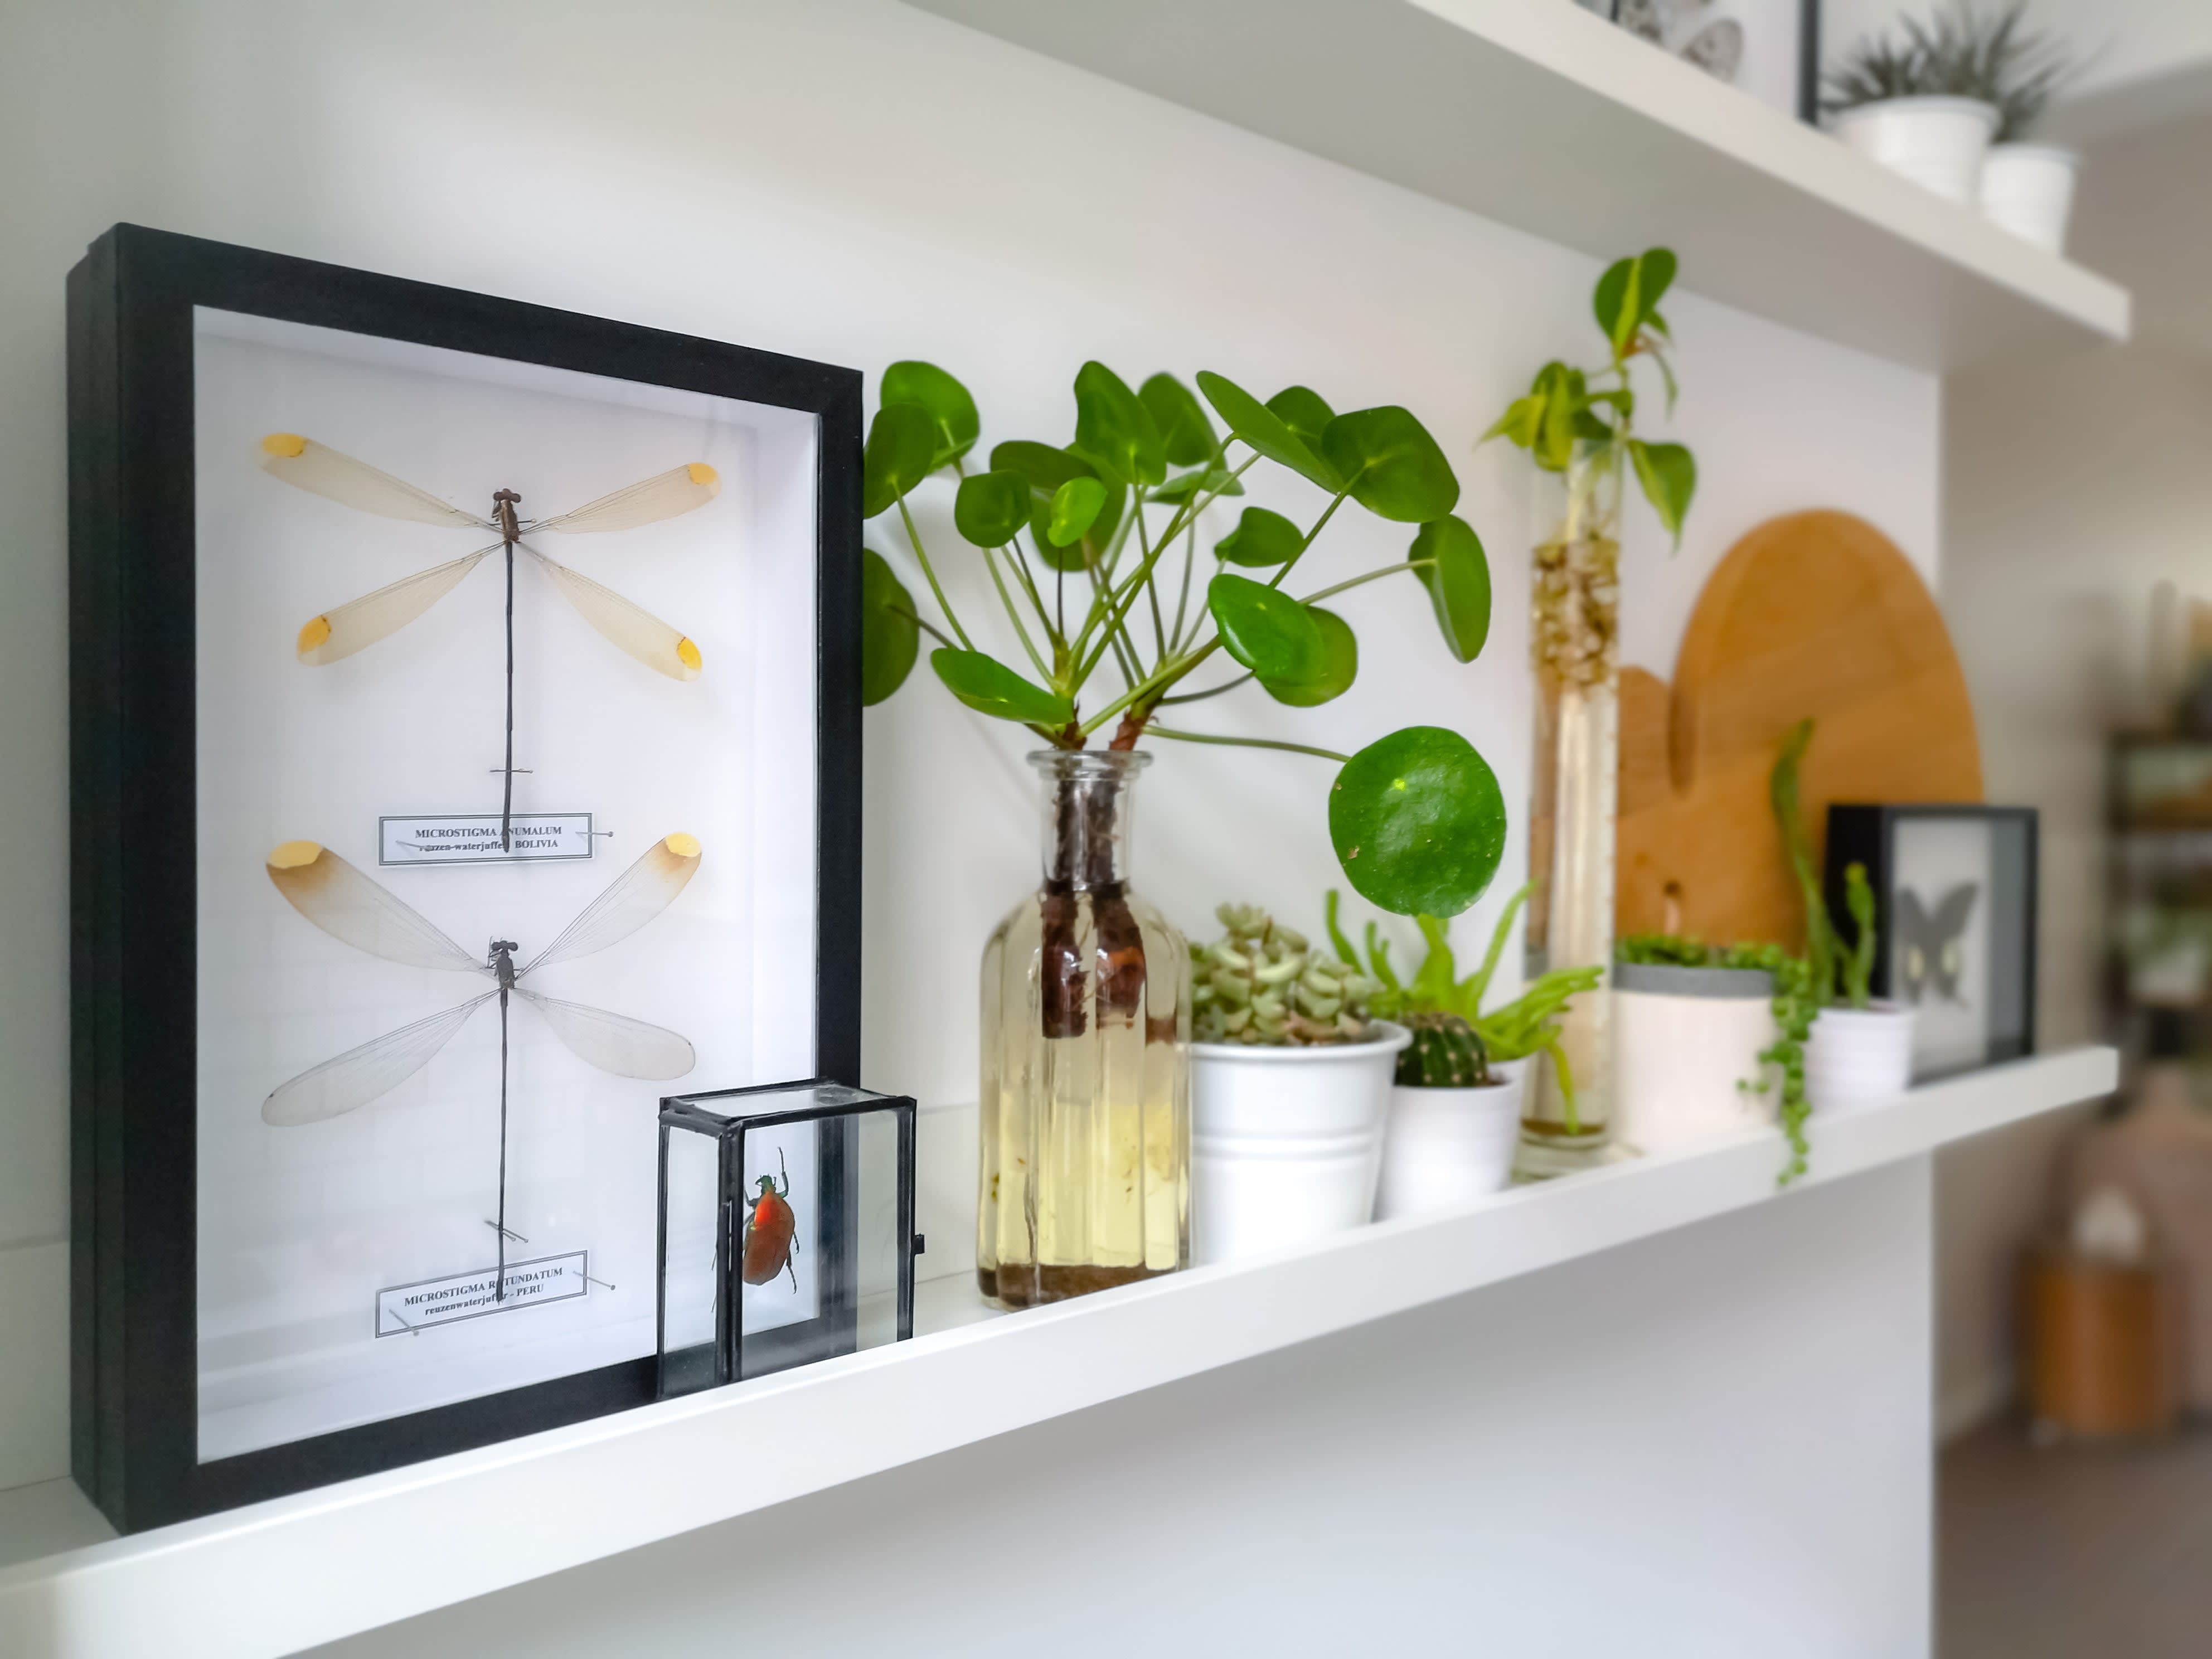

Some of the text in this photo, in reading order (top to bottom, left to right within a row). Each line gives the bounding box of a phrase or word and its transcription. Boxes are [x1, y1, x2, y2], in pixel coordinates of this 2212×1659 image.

[415, 827, 562, 838] MICROSTIGMA NUMALUM
[515, 840, 558, 848] BOLIVIA
[404, 1267, 562, 1306] MICROSTIGMA RTUNDATUM
[425, 1293, 508, 1316] reuzenwaterjufr
[516, 1284, 544, 1297] PERU
